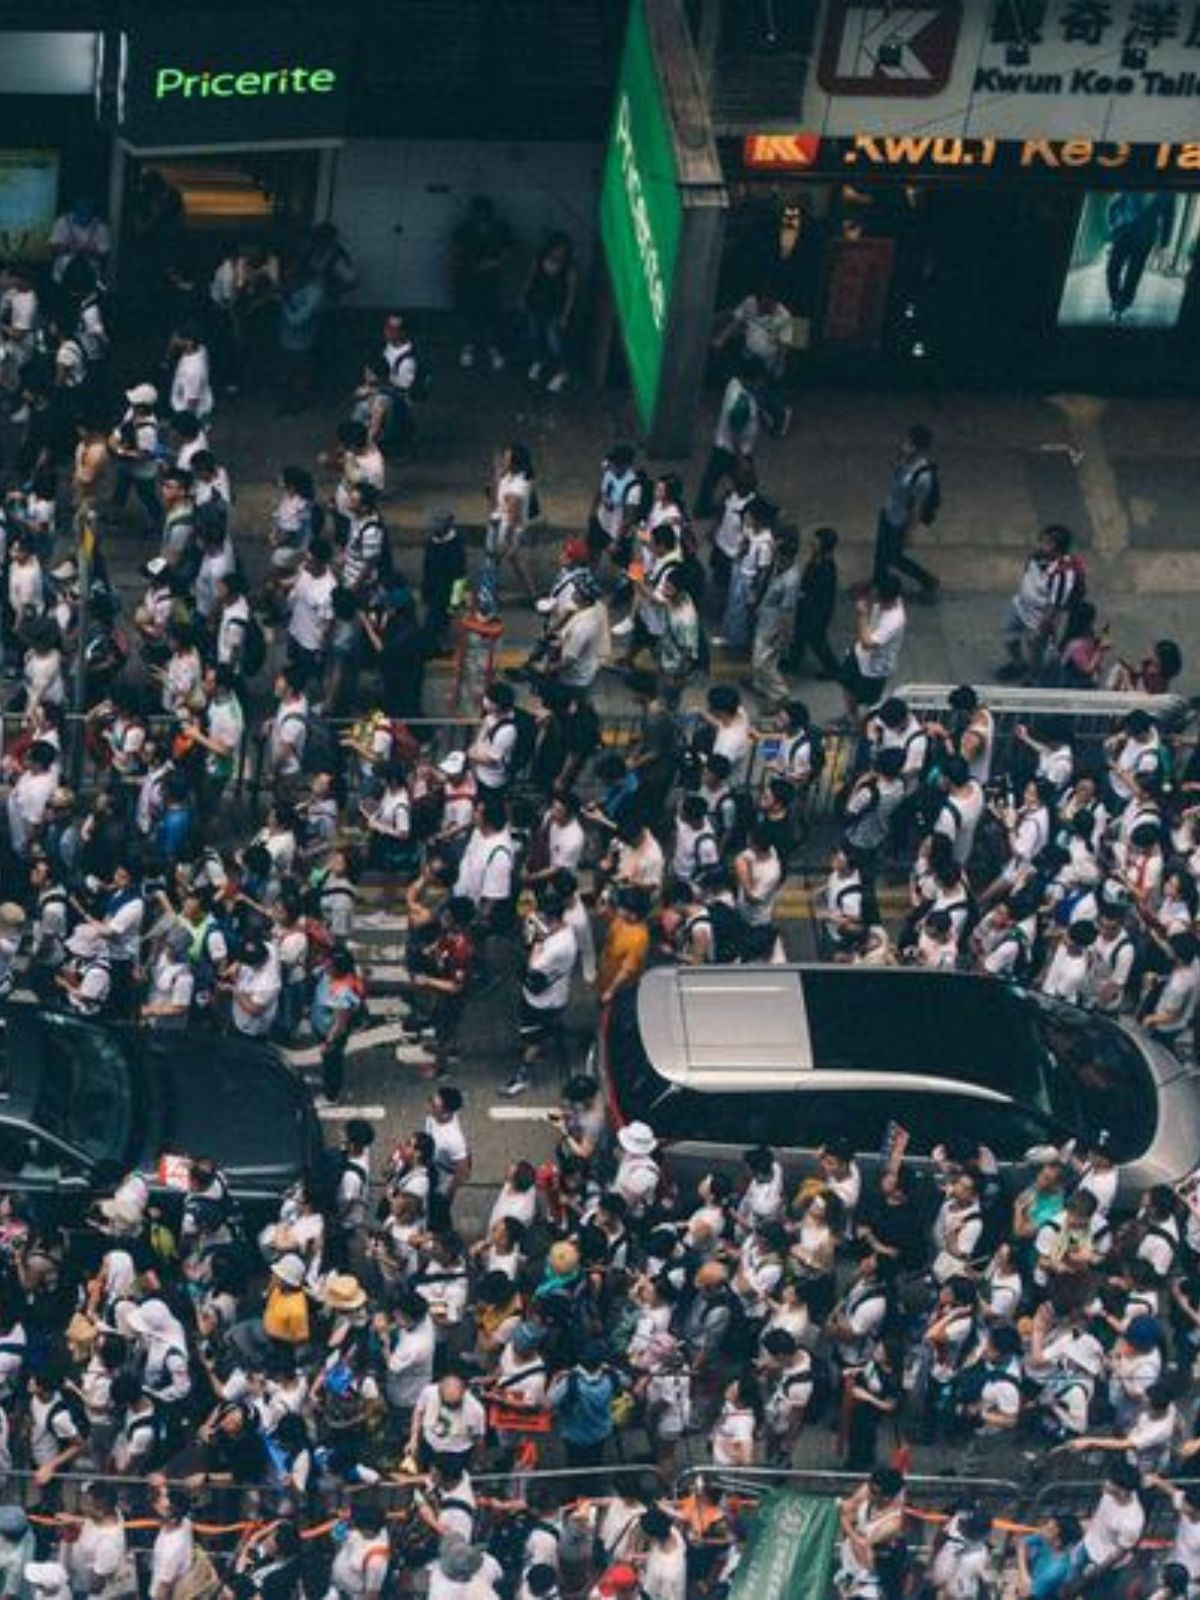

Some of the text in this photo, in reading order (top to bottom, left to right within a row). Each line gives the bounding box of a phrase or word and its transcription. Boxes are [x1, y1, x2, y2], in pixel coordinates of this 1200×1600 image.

[988, 0, 1200, 47] 觀奇洋
[156, 67, 337, 98] Pricerite
[973, 67, 1063, 94] Kwun
